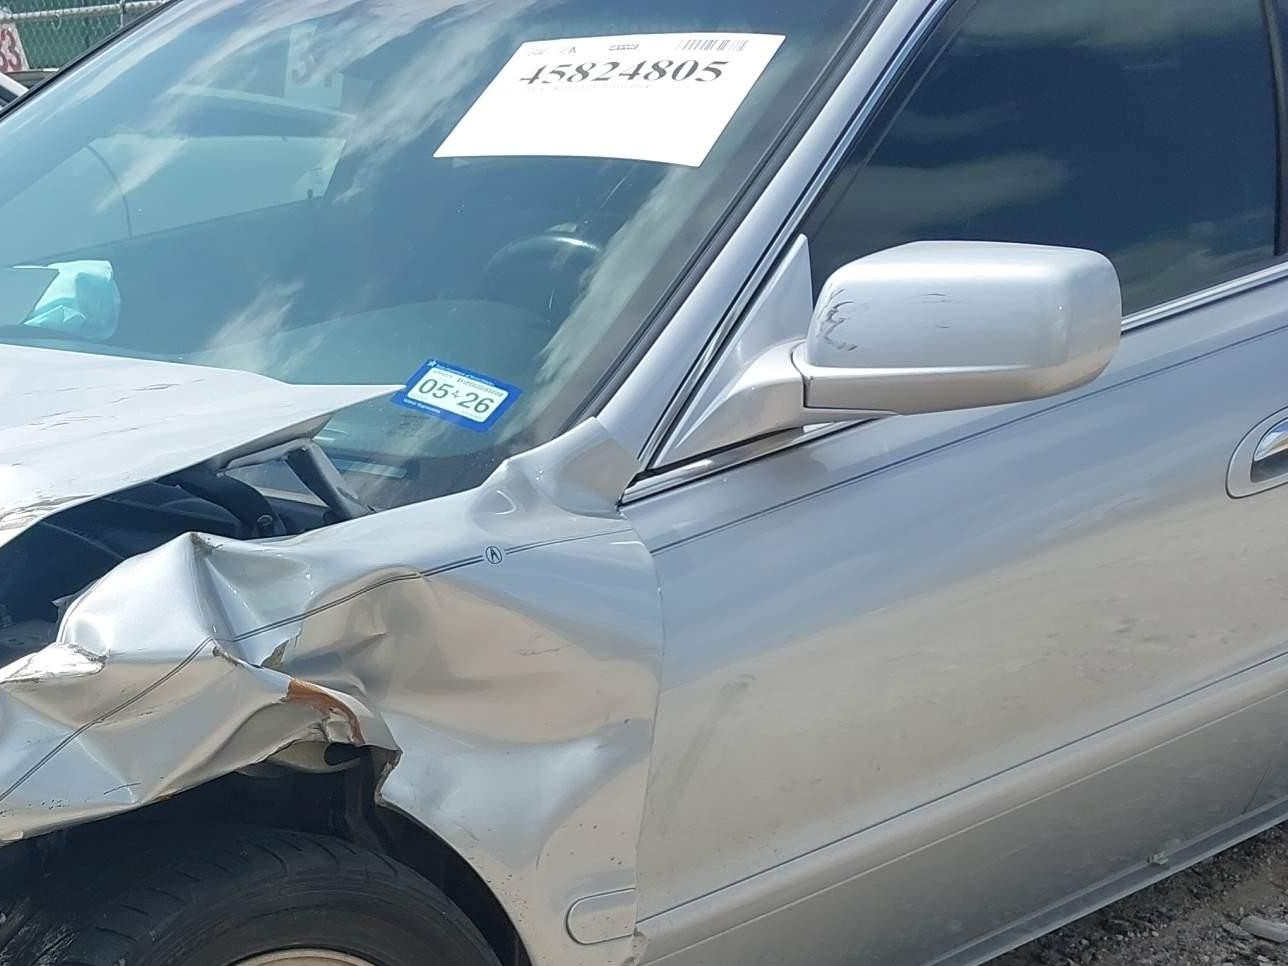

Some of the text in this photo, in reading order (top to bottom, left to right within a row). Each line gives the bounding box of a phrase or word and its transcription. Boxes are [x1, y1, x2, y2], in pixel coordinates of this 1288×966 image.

[520, 59, 729, 84] 45824805
[418, 378, 454, 399] 05
[456, 392, 495, 414] 26
